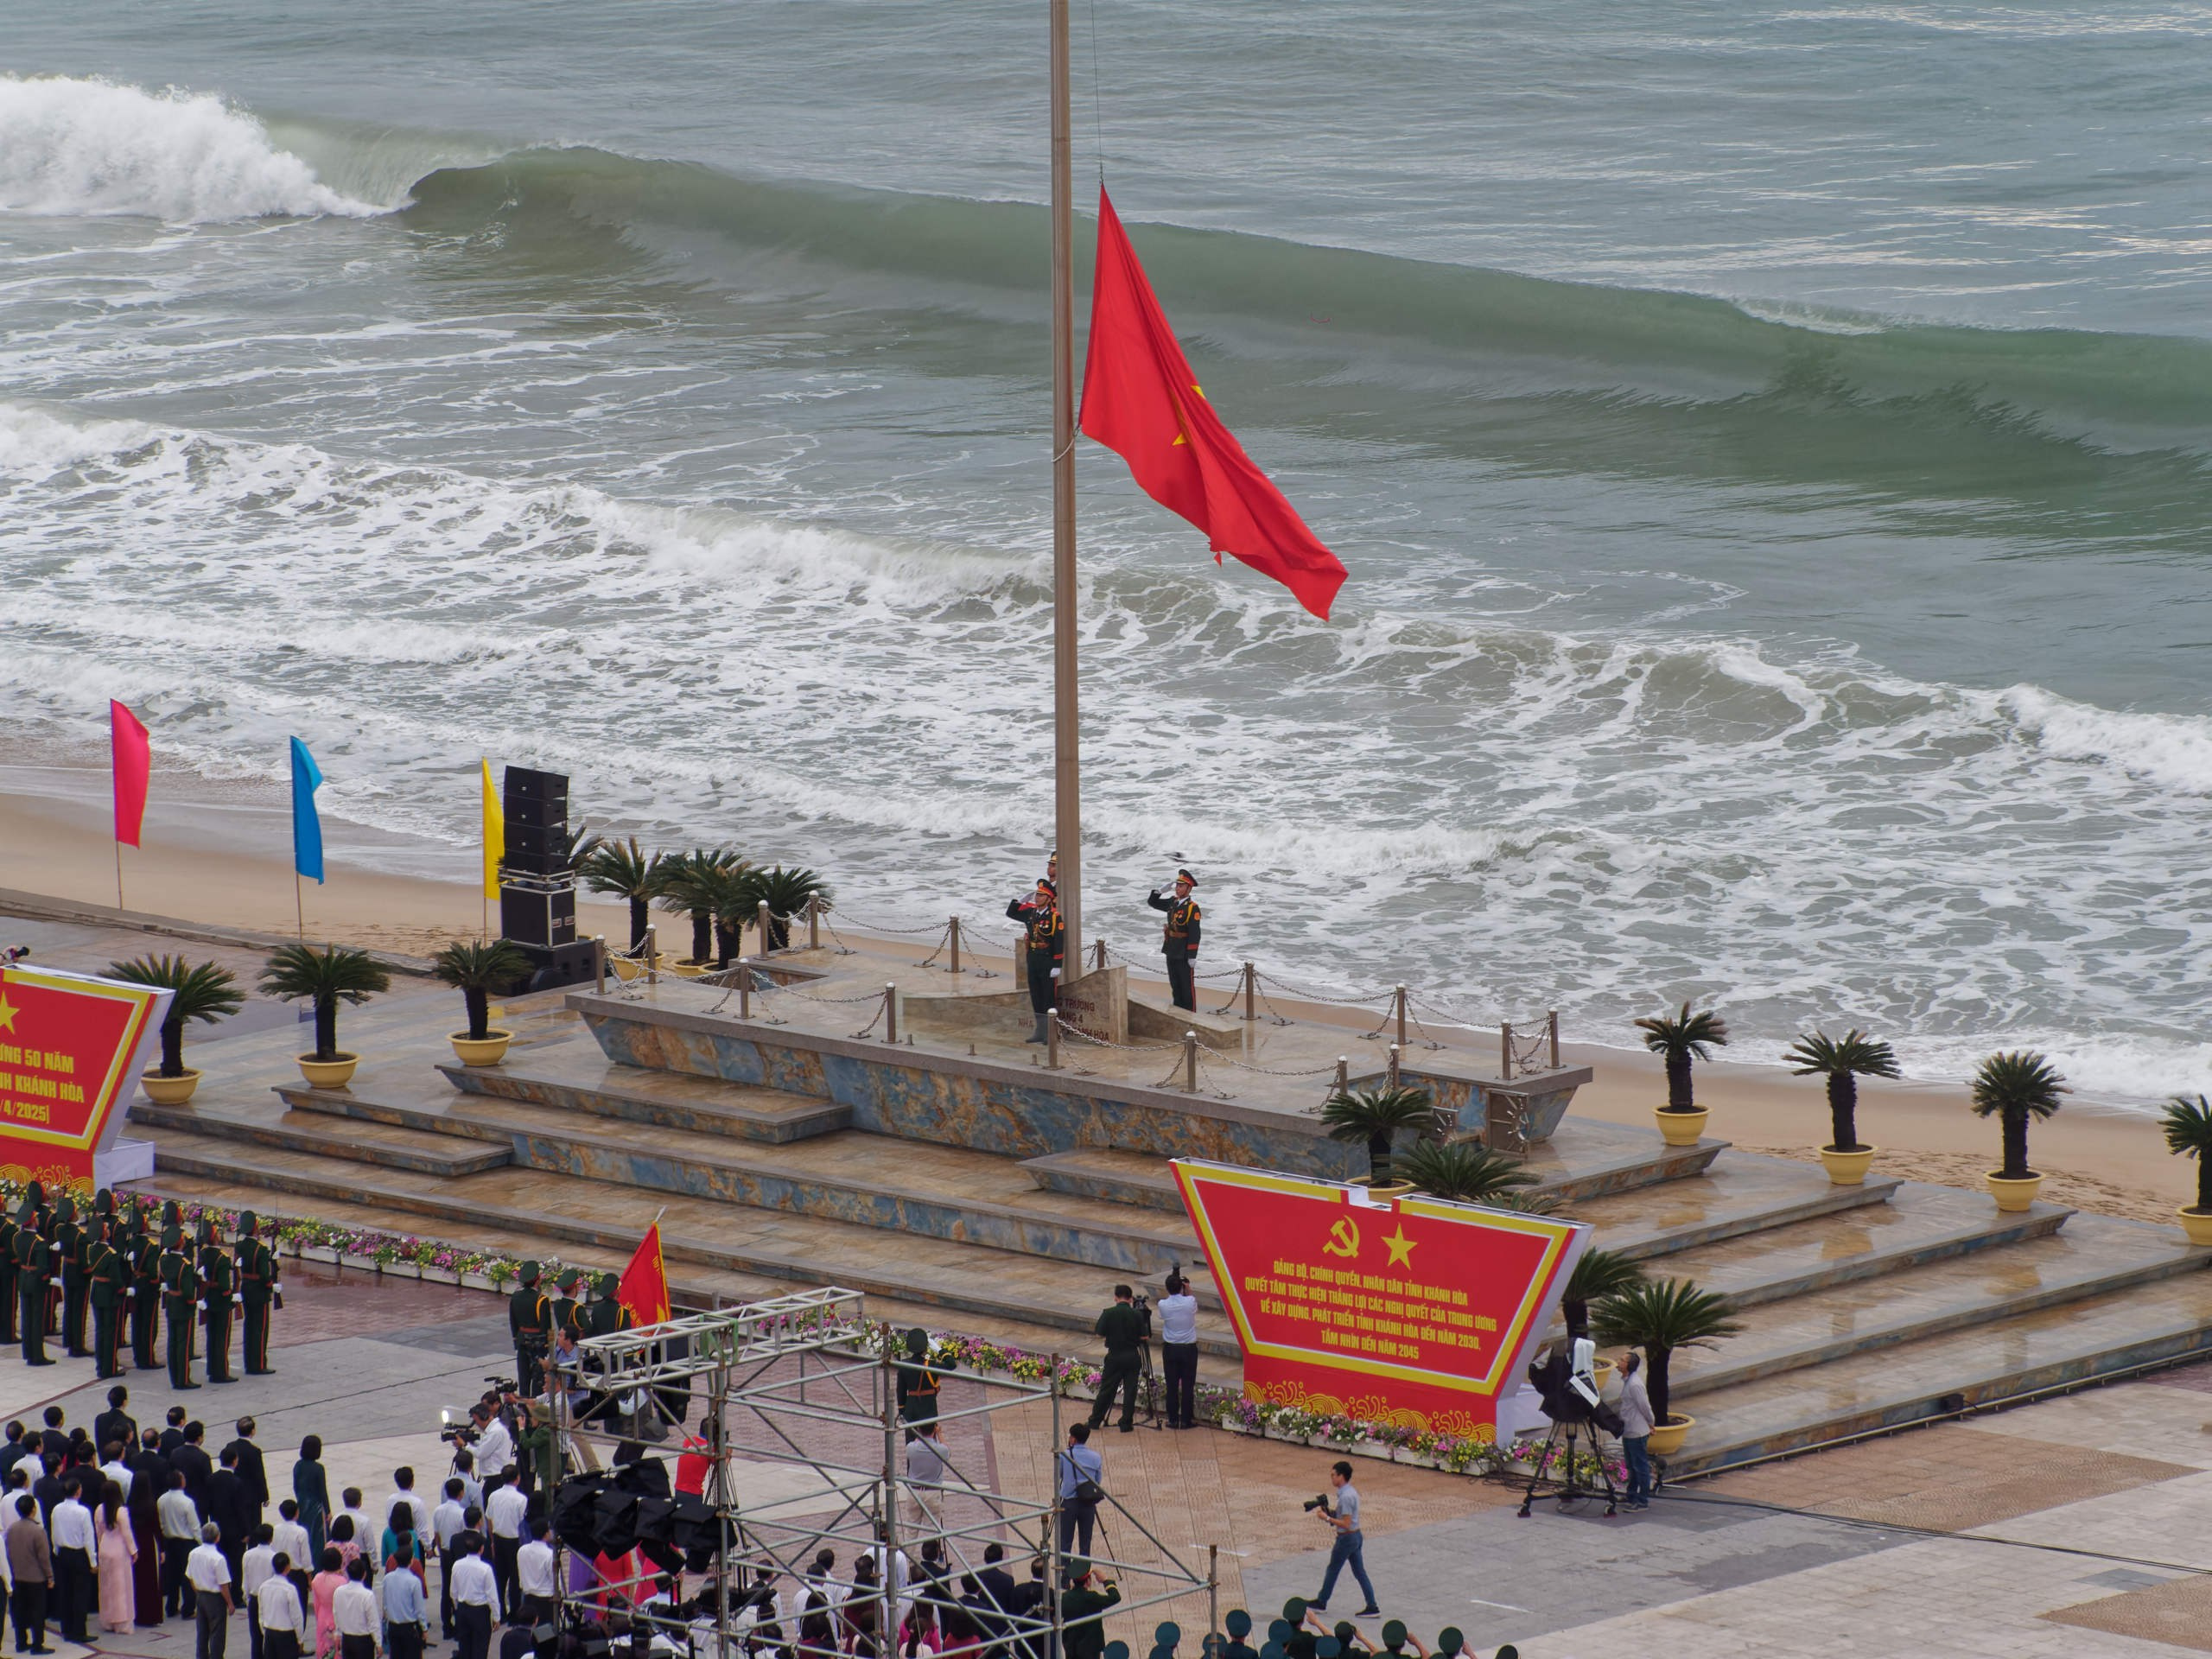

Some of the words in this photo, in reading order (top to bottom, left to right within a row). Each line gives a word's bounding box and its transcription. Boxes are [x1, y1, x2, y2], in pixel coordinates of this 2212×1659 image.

[24, 1048, 41, 1068] 50
[44, 1051, 74, 1074] NĂM
[16, 1075, 57, 1098] KHÁNH
[60, 1081, 85, 1103] HÒA
[1273, 1258, 1294, 1276] ĐẢNG
[1310, 1265, 1333, 1282] CHÍNH
[1363, 1275, 1385, 1292] NHÂN
[1387, 1279, 1402, 1295] DÂN
[1404, 1279, 1422, 1299] TỈNH
[1424, 1285, 1451, 1303] KHÁNH
[1452, 1288, 1468, 1306] HÒA
[1245, 1275, 1268, 1294] QUYẾT
[1269, 1279, 1287, 1295] TÂM
[1288, 1283, 1307, 1301] THỰC
[1309, 1286, 1326, 1305] HIỆN
[1328, 1287, 1353, 1307] THẮNG
[1368, 1296, 1383, 1313] CÁC
[1385, 1300, 1404, 1319] NGHỊ
[1405, 1303, 1428, 1320] QUYẾT
[1430, 1306, 1446, 1324] CỦA
[1447, 1310, 1473, 1328] TRUNG
[1261, 1297, 1270, 1313] VỀ
[1272, 1300, 1287, 1316] XÂY
[1313, 1307, 1332, 1324] PHÁT
[1333, 1309, 1355, 1328] TRIỂN
[1356, 1313, 1374, 1332] TỈNH
[1375, 1319, 1402, 1336] KHÁNH
[1403, 1322, 1419, 1339] HÒA
[1421, 1325, 1436, 1342] ĐẾN
[1437, 1329, 1457, 1345] NĂM
[1458, 1333, 1481, 1351] 2030,
[1340, 1332, 1359, 1350] NHÌN
[1361, 1334, 1376, 1353] ĐẾN
[1377, 1338, 1397, 1356] NĂM
[1398, 1344, 1420, 1360] 2045
